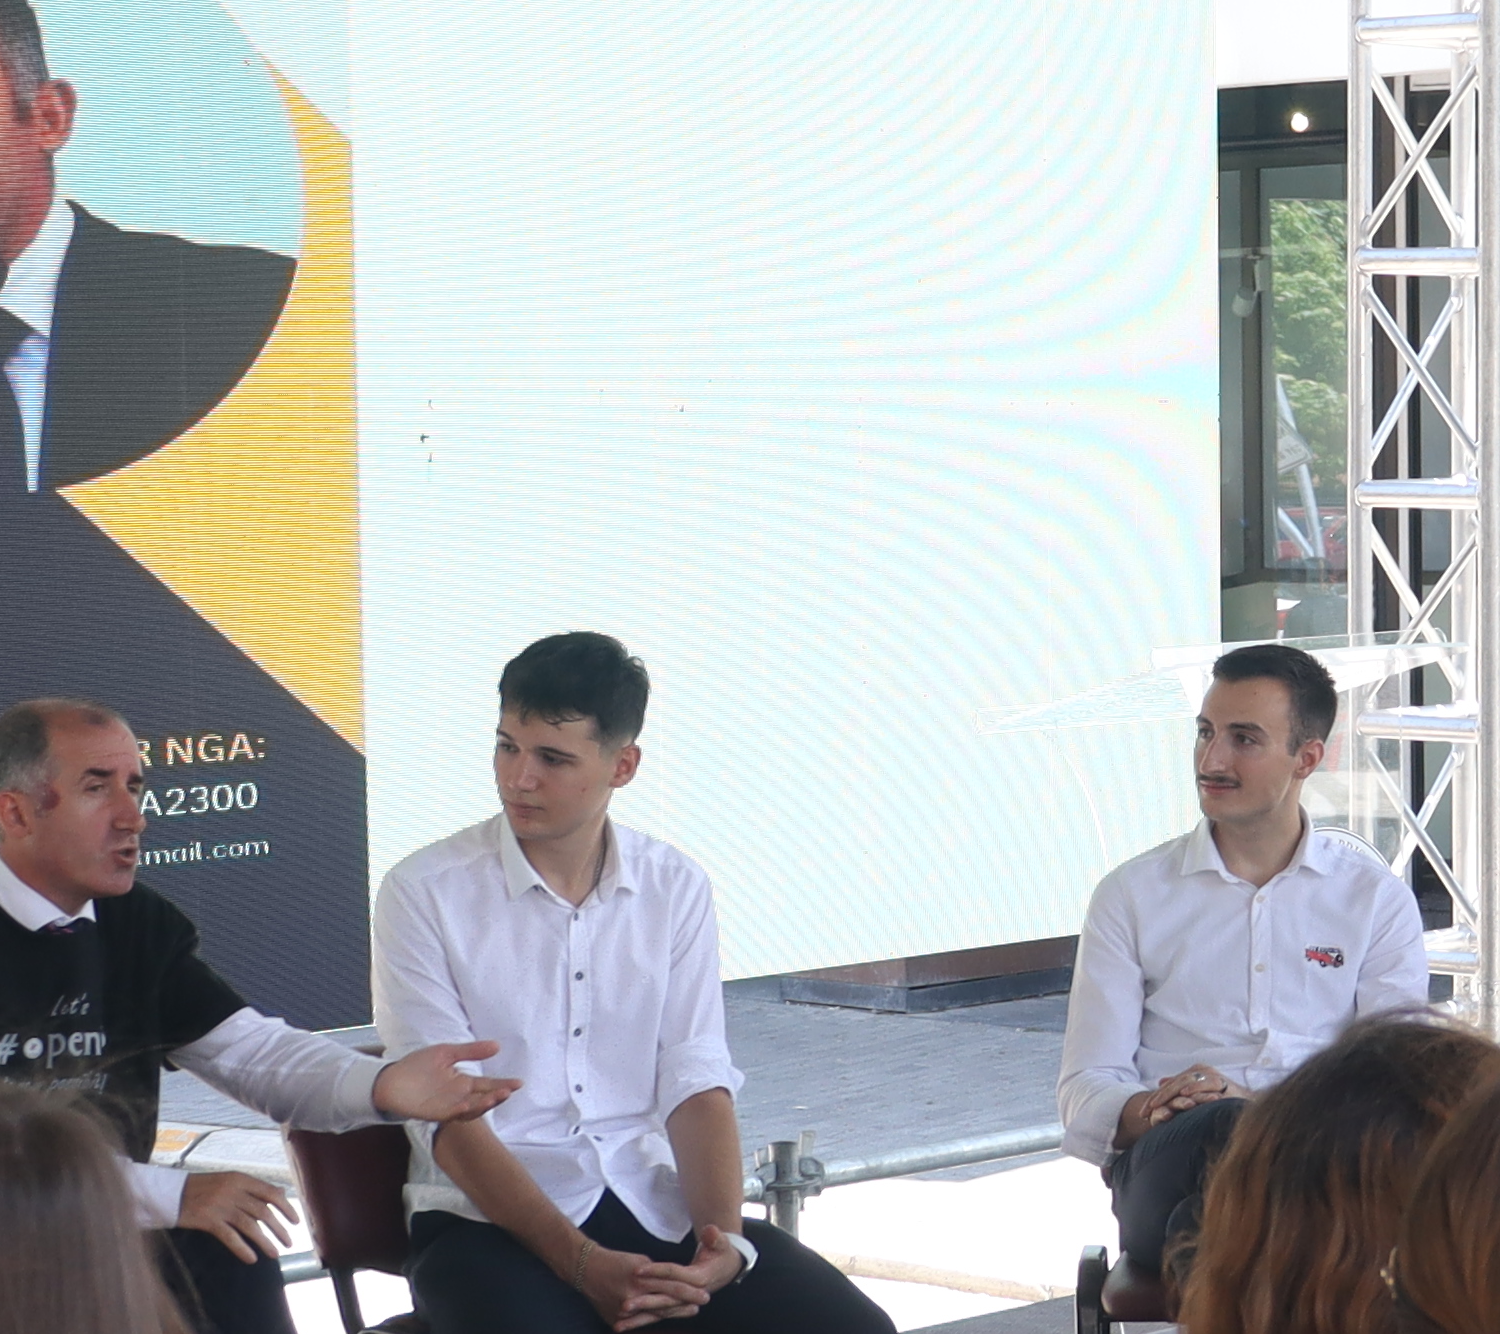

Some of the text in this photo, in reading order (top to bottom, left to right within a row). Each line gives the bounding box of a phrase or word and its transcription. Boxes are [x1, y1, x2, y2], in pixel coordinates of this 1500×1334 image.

[164, 731, 266, 765] NGA:
[140, 782, 258, 816] A2300
[137, 841, 270, 866] mail.com
